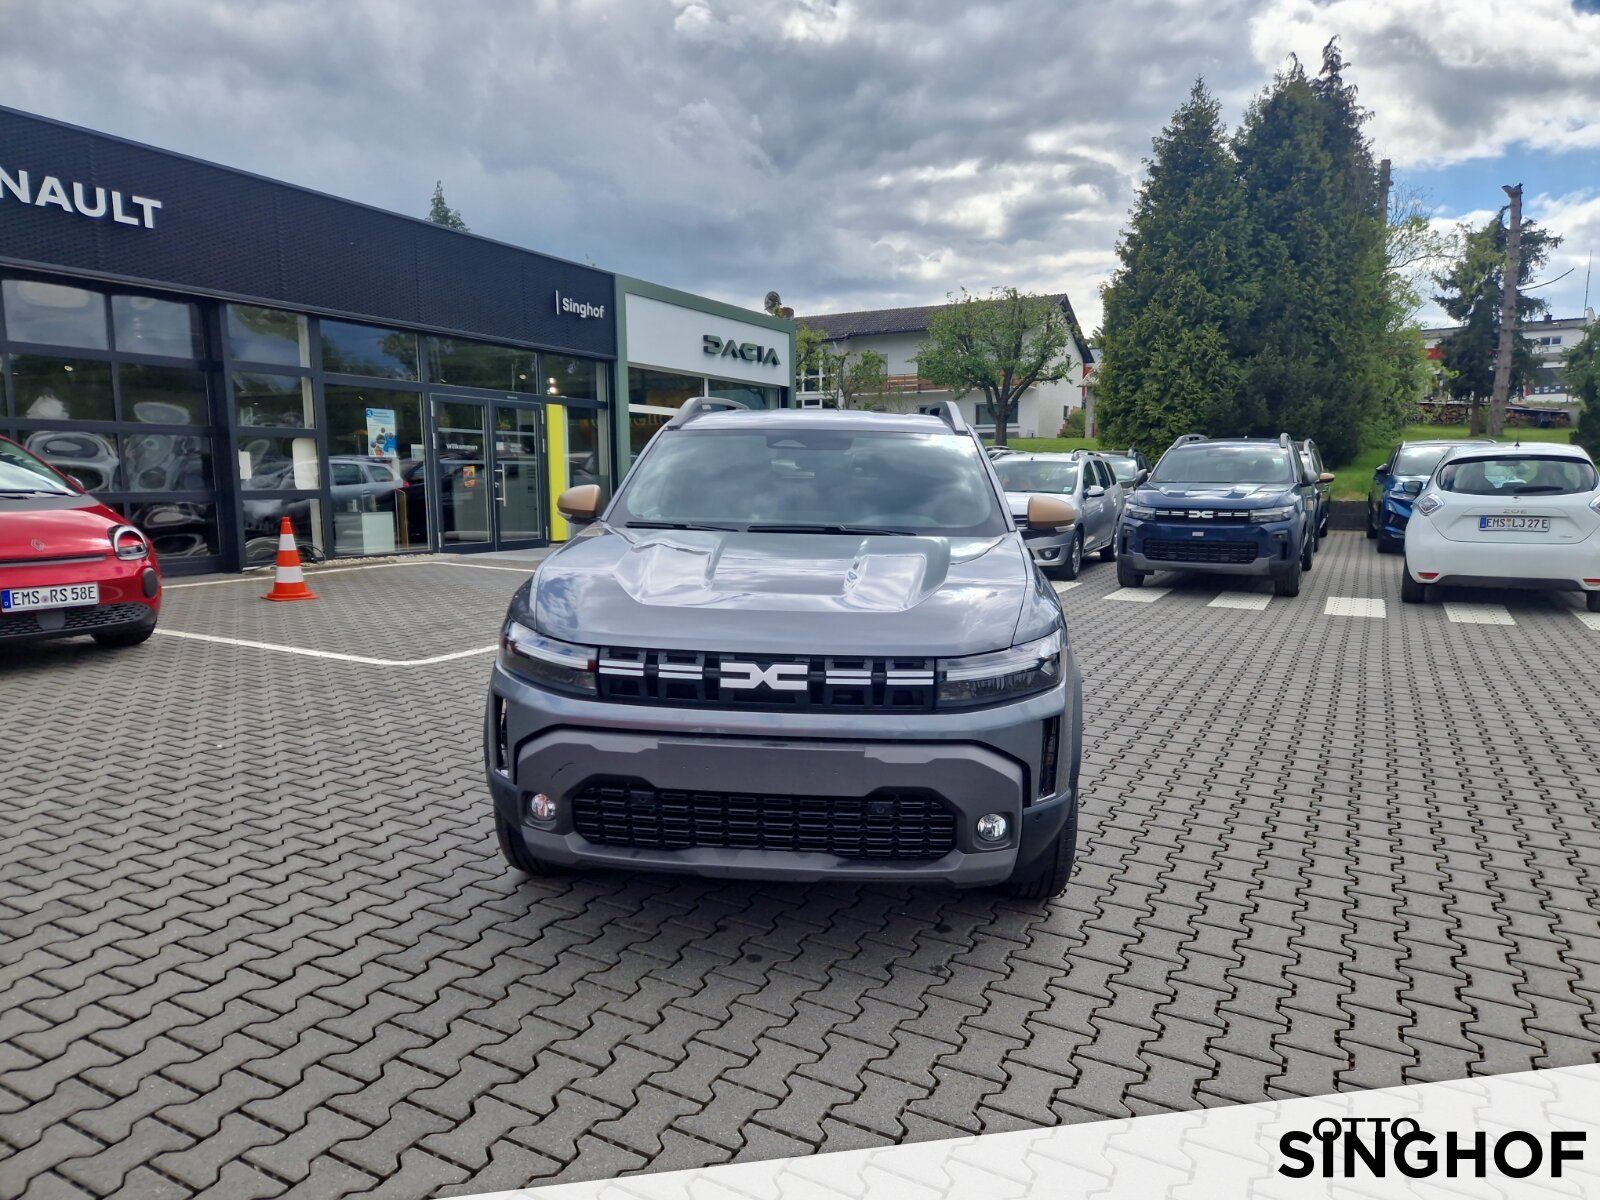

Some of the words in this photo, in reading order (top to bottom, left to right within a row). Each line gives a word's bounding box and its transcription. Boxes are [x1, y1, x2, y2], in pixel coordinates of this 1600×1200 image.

[562, 297, 605, 319] Singhof
[703, 335, 781, 366] DACIA
[1486, 518, 1505, 528] EMS
[12, 590, 40, 606] EMS
[50, 588, 68, 602] RS
[71, 586, 96, 601] 58E
